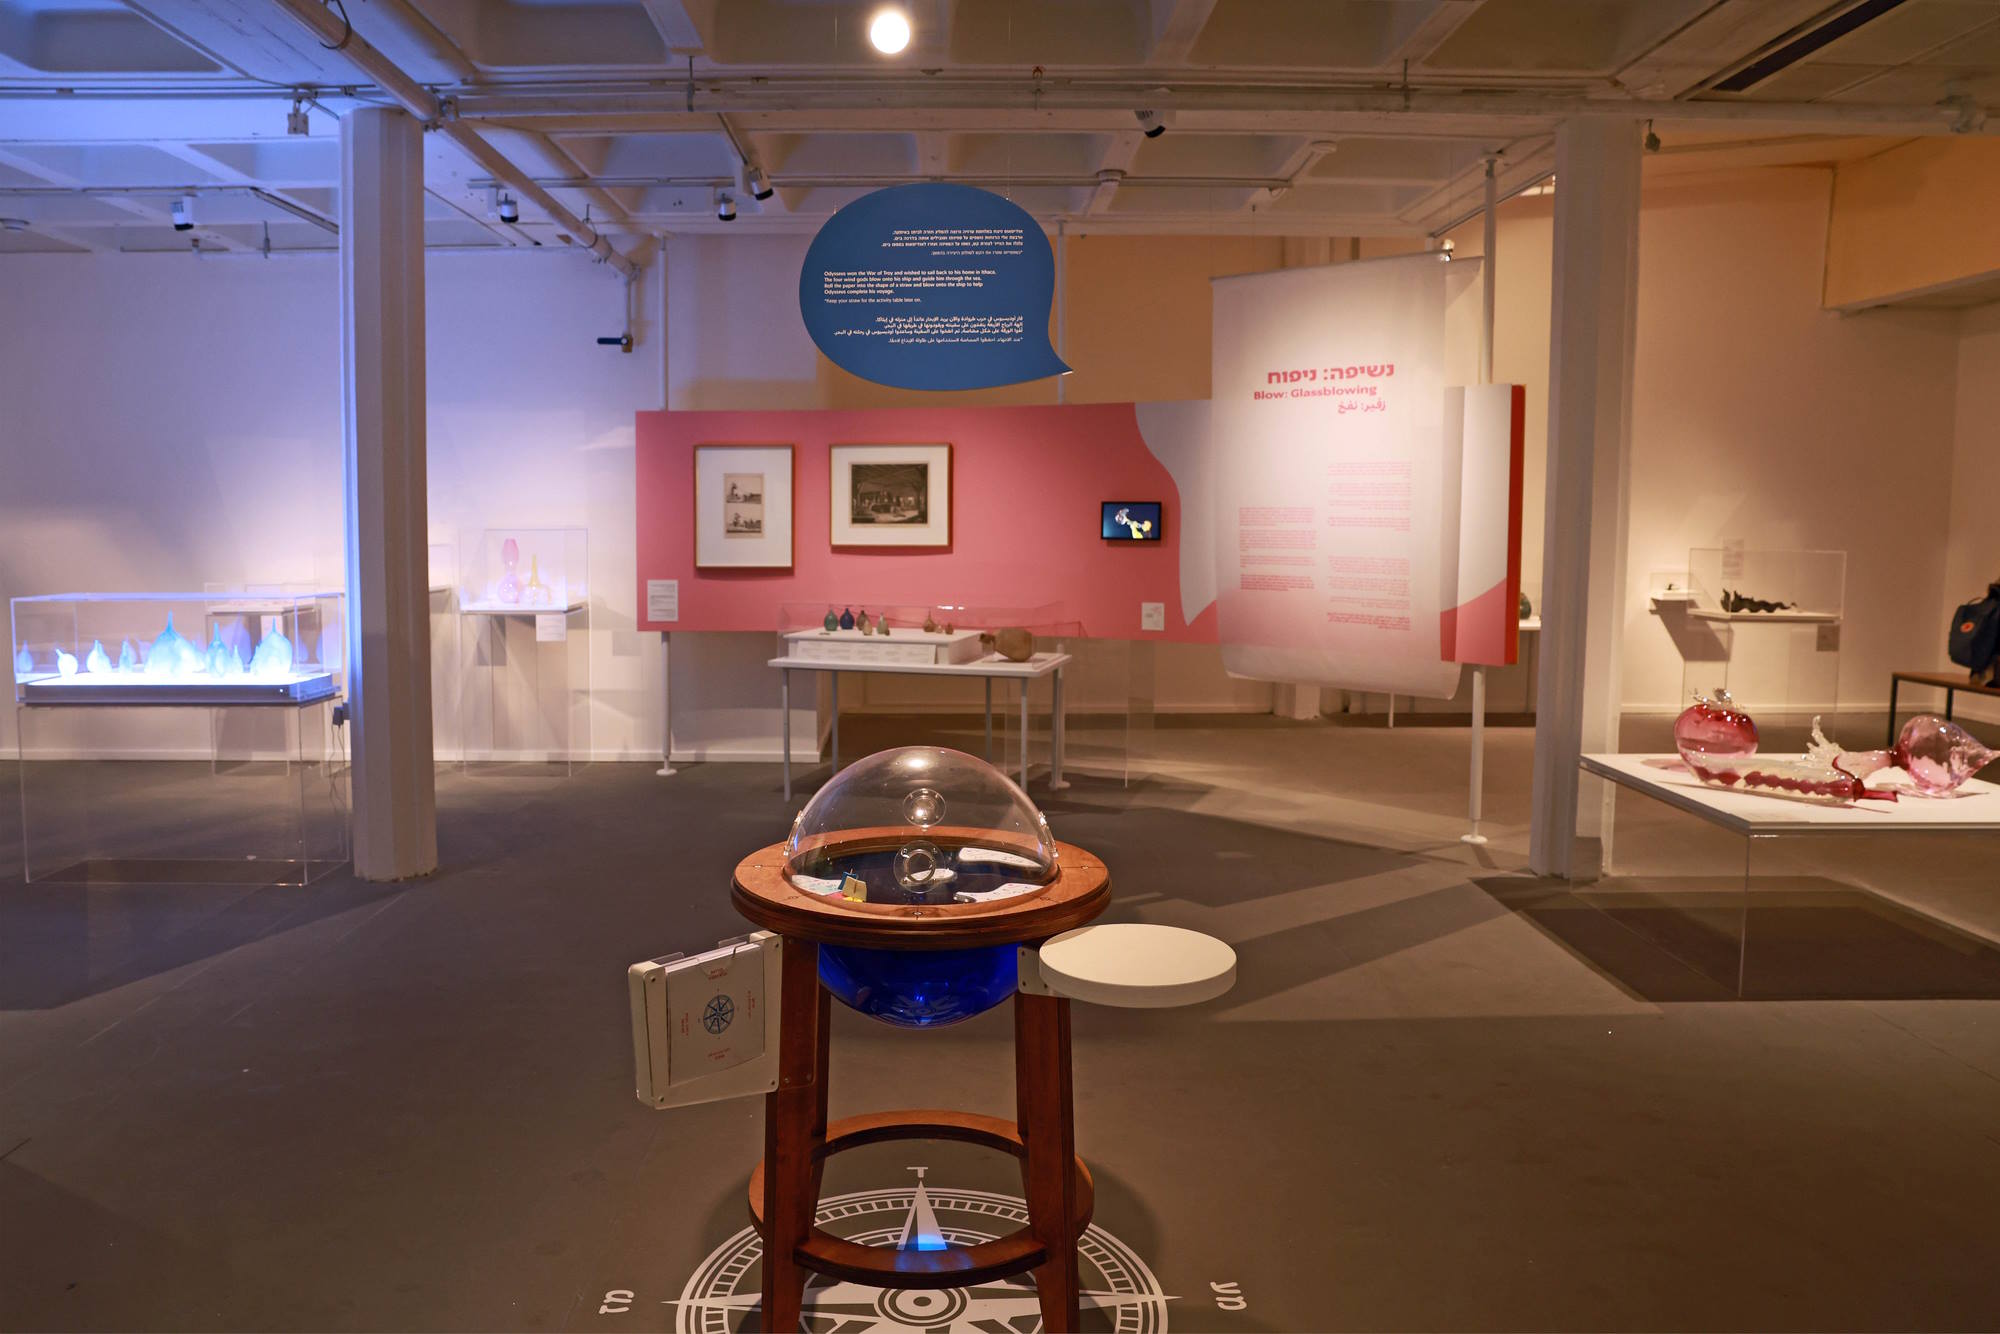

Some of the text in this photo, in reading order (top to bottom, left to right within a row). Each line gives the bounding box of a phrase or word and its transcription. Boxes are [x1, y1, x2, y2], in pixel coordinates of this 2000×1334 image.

[1267, 363, 1394, 384] נשיפה: ניפוח
[1254, 385, 1377, 400] Blow: Glassblowing
[1338, 397, 1386, 414] زفير: نفخ
